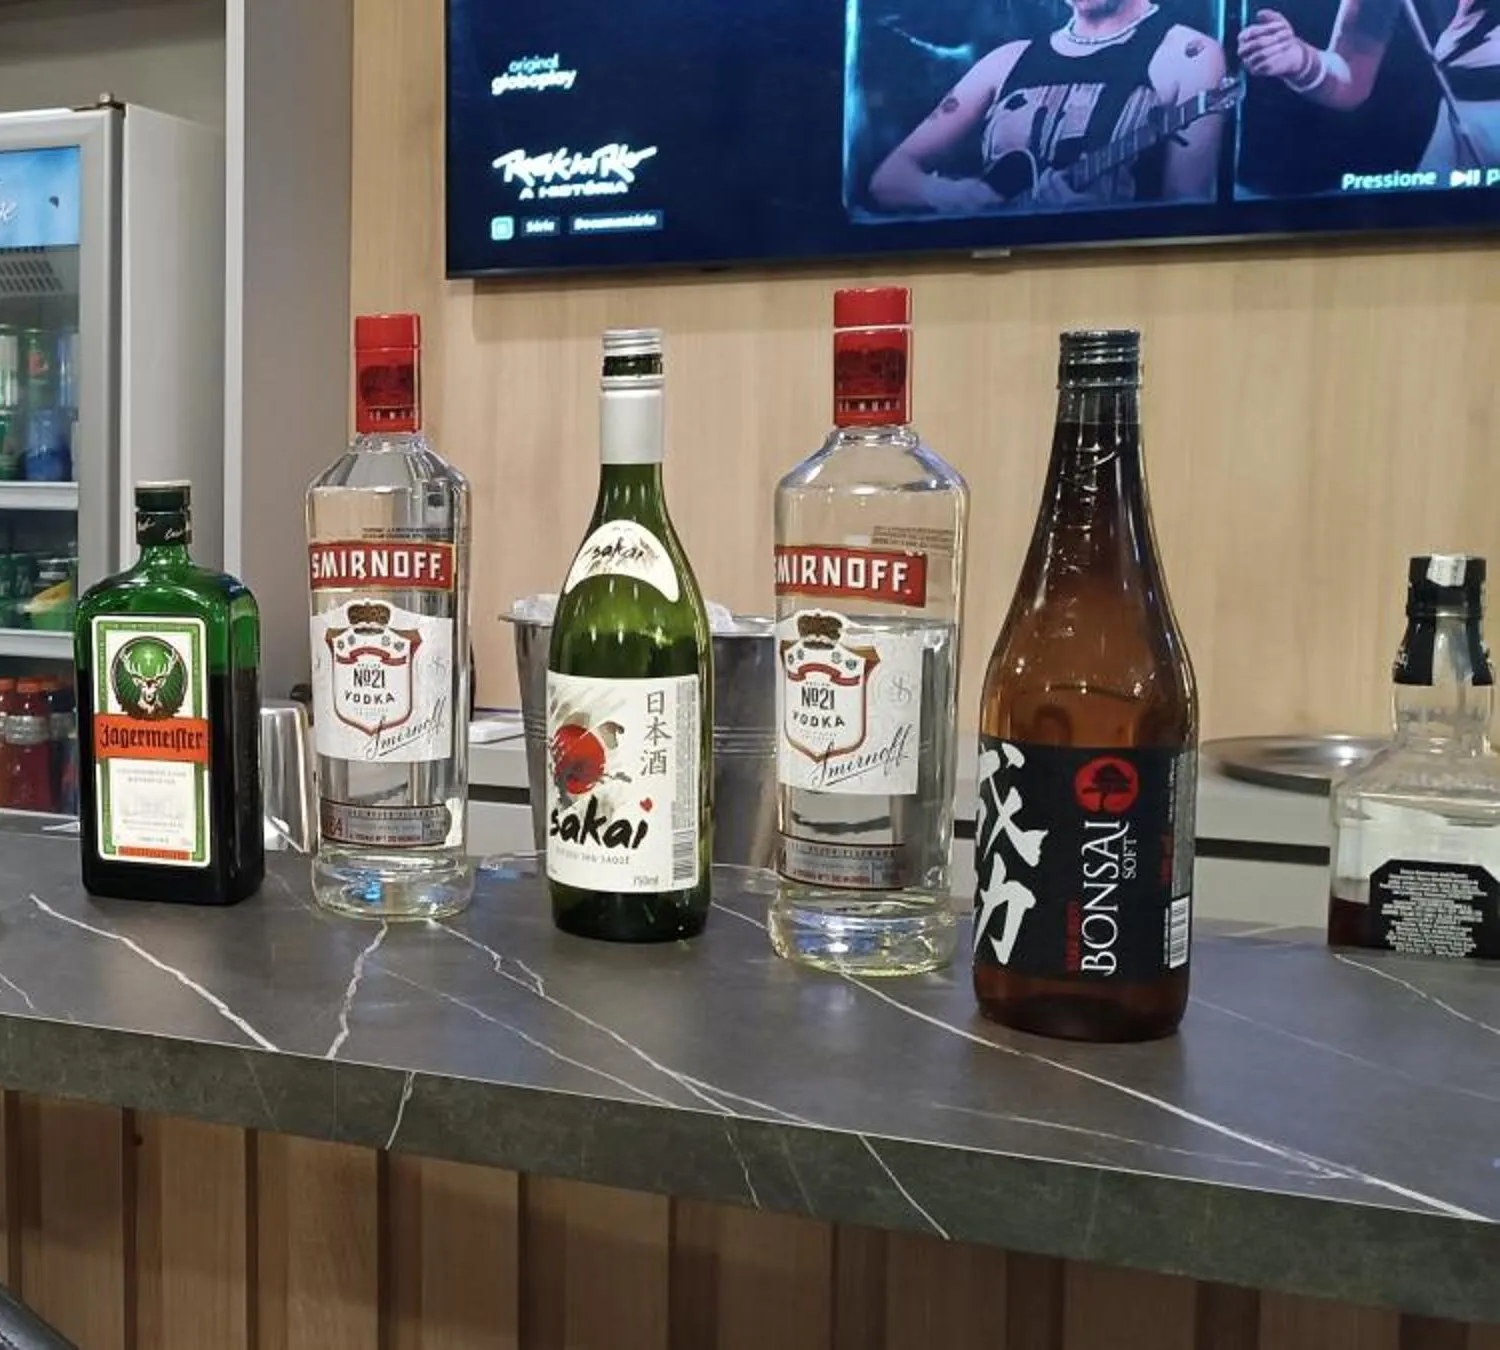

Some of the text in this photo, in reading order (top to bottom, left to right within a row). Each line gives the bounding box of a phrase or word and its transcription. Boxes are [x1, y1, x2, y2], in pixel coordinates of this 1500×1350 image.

[509, 54, 559, 73] original
[491, 70, 577, 96] globoplay
[1342, 170, 1437, 190] Pressione
[344, 690, 395, 705] VODKA
[792, 709, 846, 728] VODKA
[640, 690, 672, 775] 日本酒
[550, 794, 649, 850] sakai
[1122, 837, 1138, 880] SOFT
[1081, 819, 1130, 977] BONSAI
